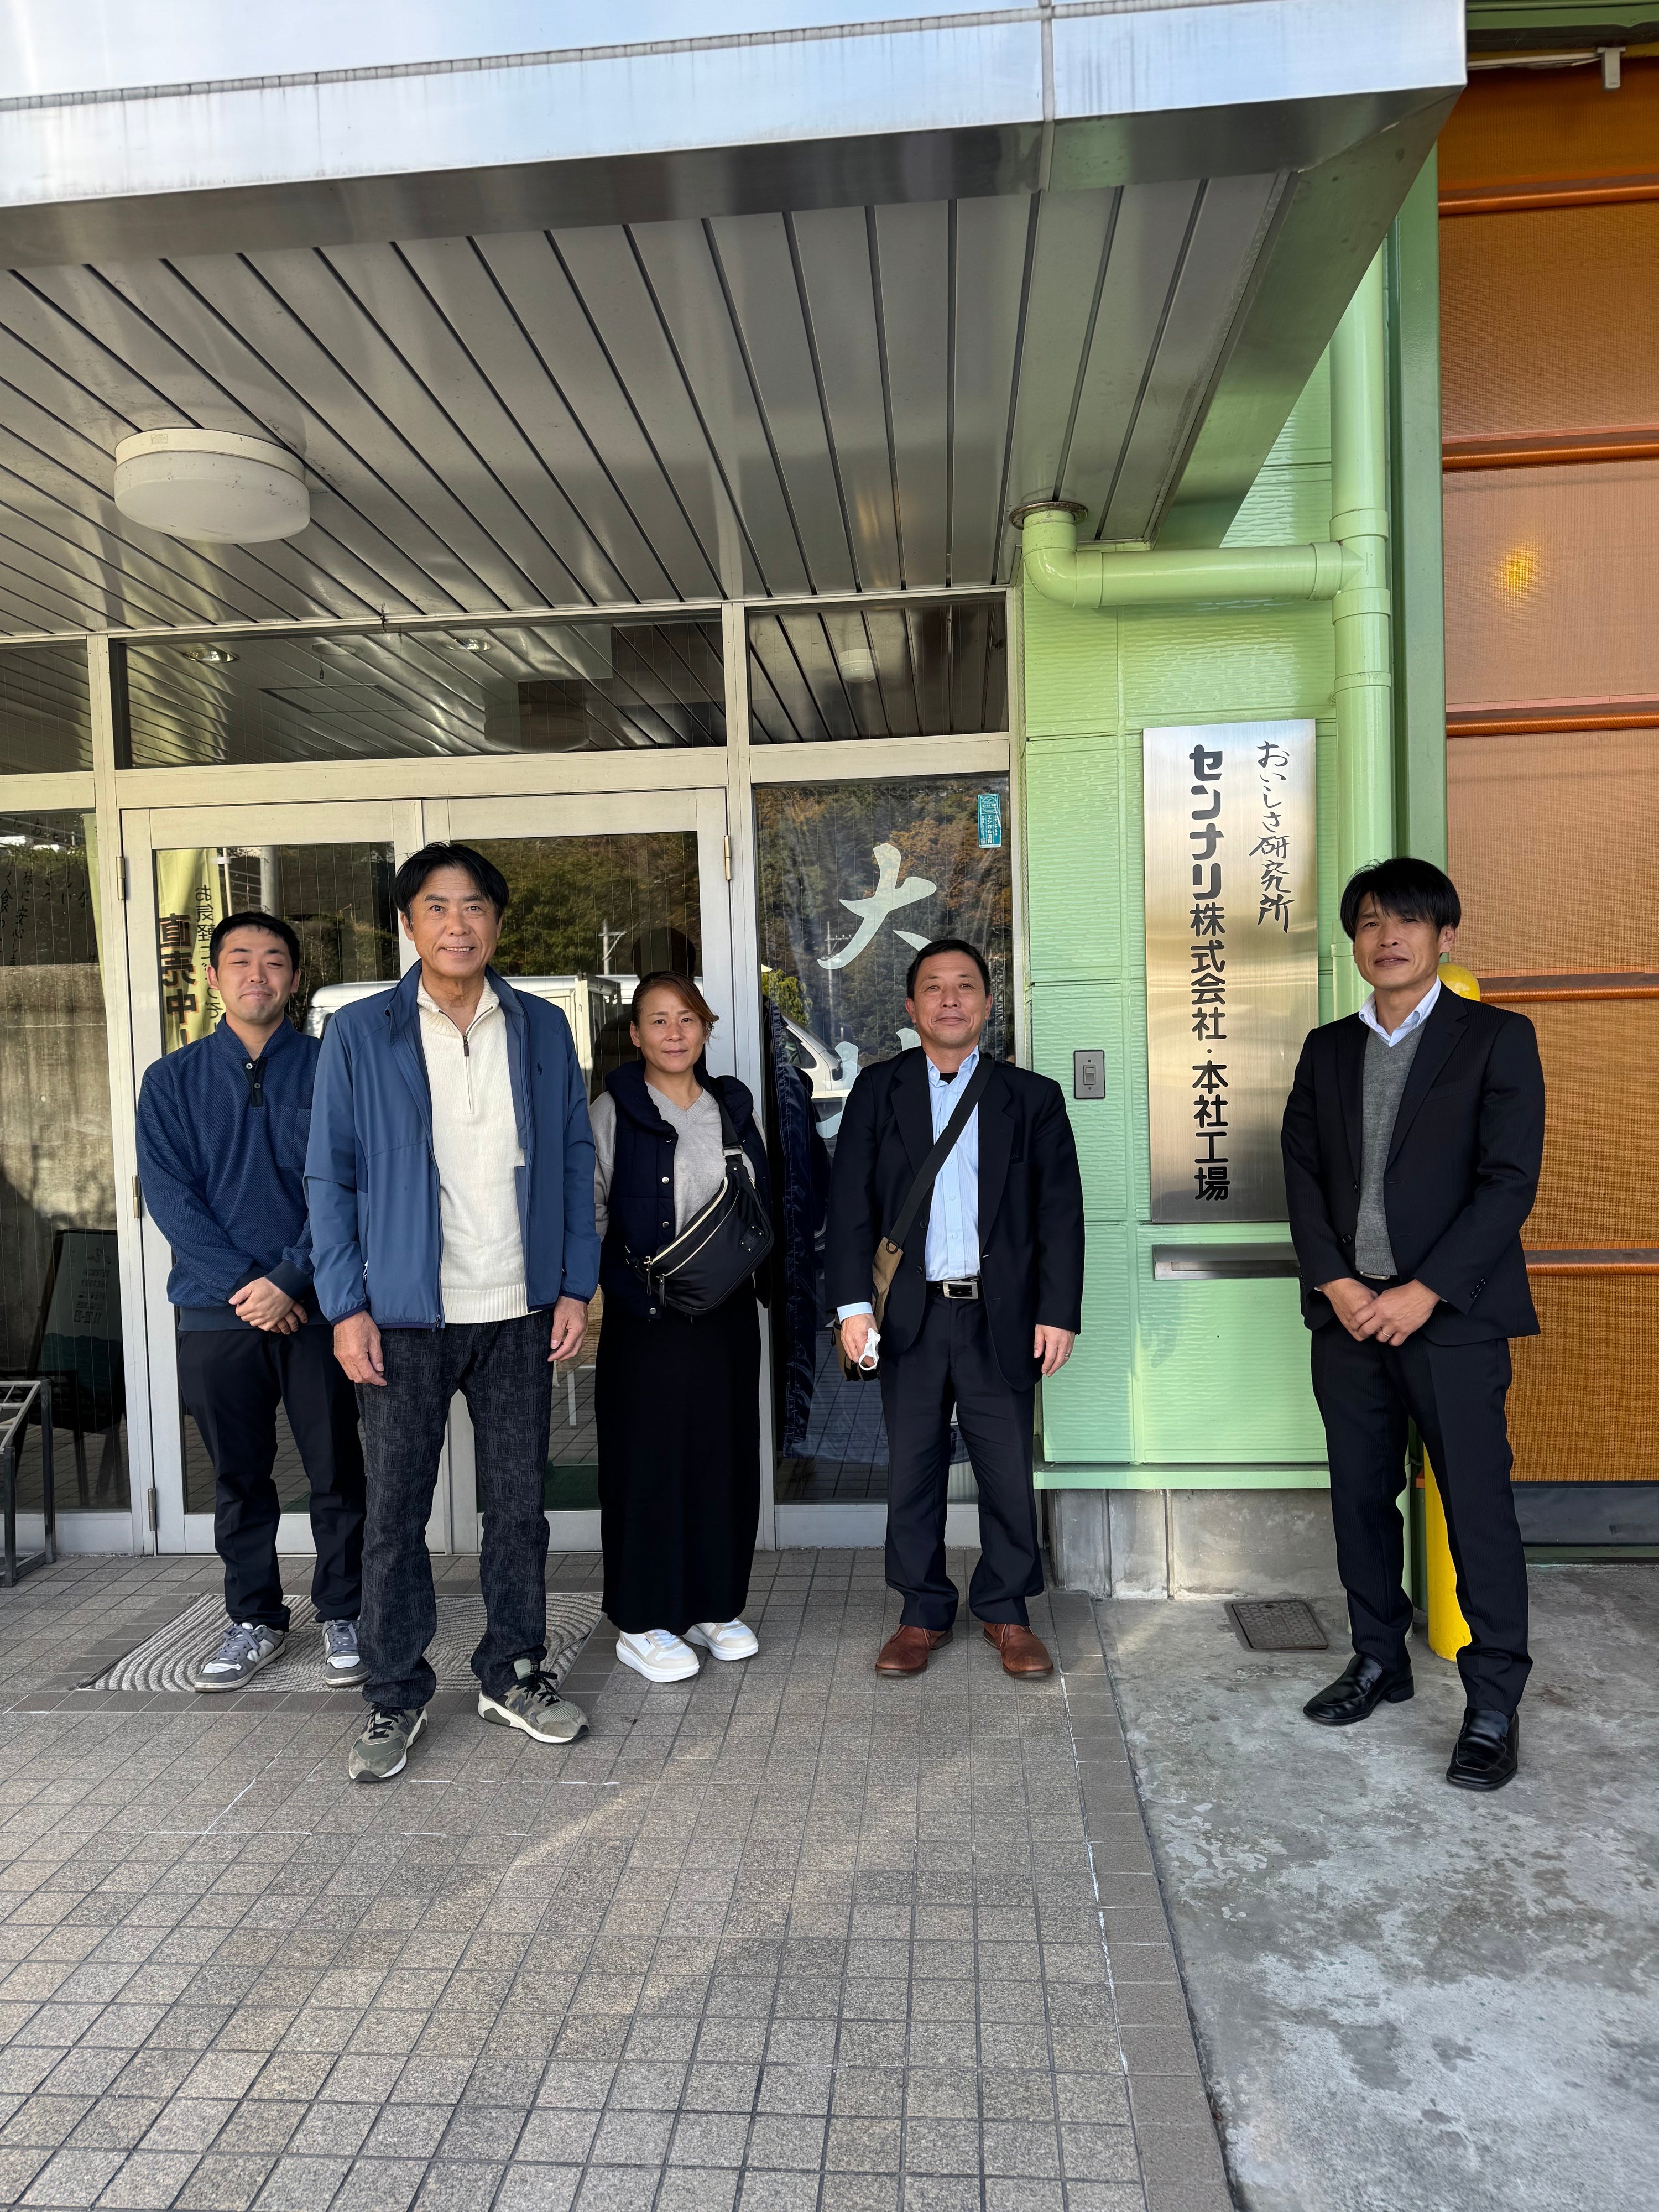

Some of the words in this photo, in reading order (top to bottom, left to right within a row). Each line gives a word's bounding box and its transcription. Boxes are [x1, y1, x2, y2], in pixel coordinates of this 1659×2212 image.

[1249, 740, 1295, 933] おいしさ研究所
